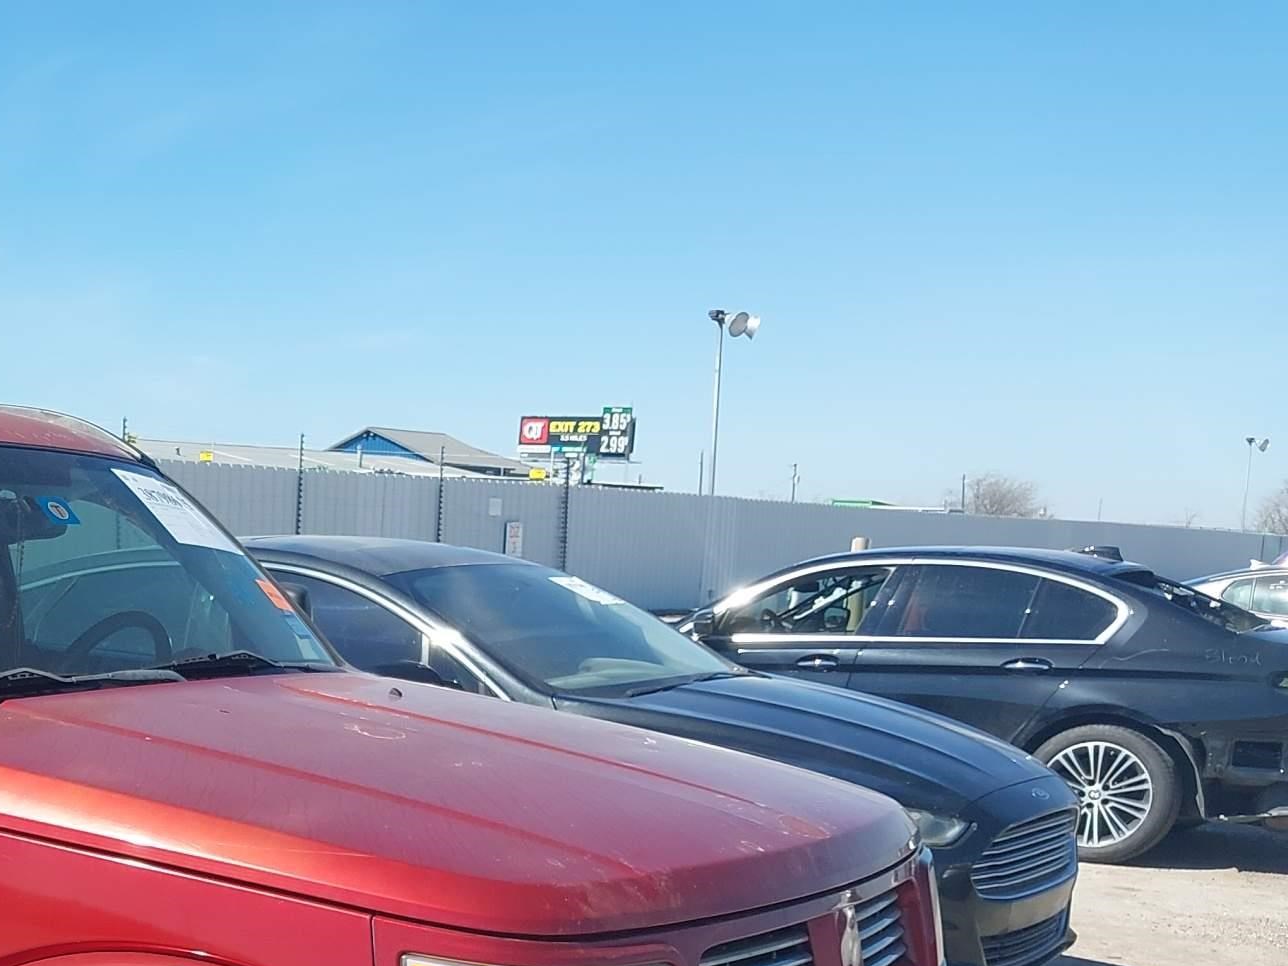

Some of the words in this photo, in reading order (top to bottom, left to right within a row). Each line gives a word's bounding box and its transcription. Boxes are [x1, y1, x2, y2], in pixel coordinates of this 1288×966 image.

[523, 422, 545, 440] QT
[549, 421, 577, 433] EXIT
[577, 421, 601, 433] 273
